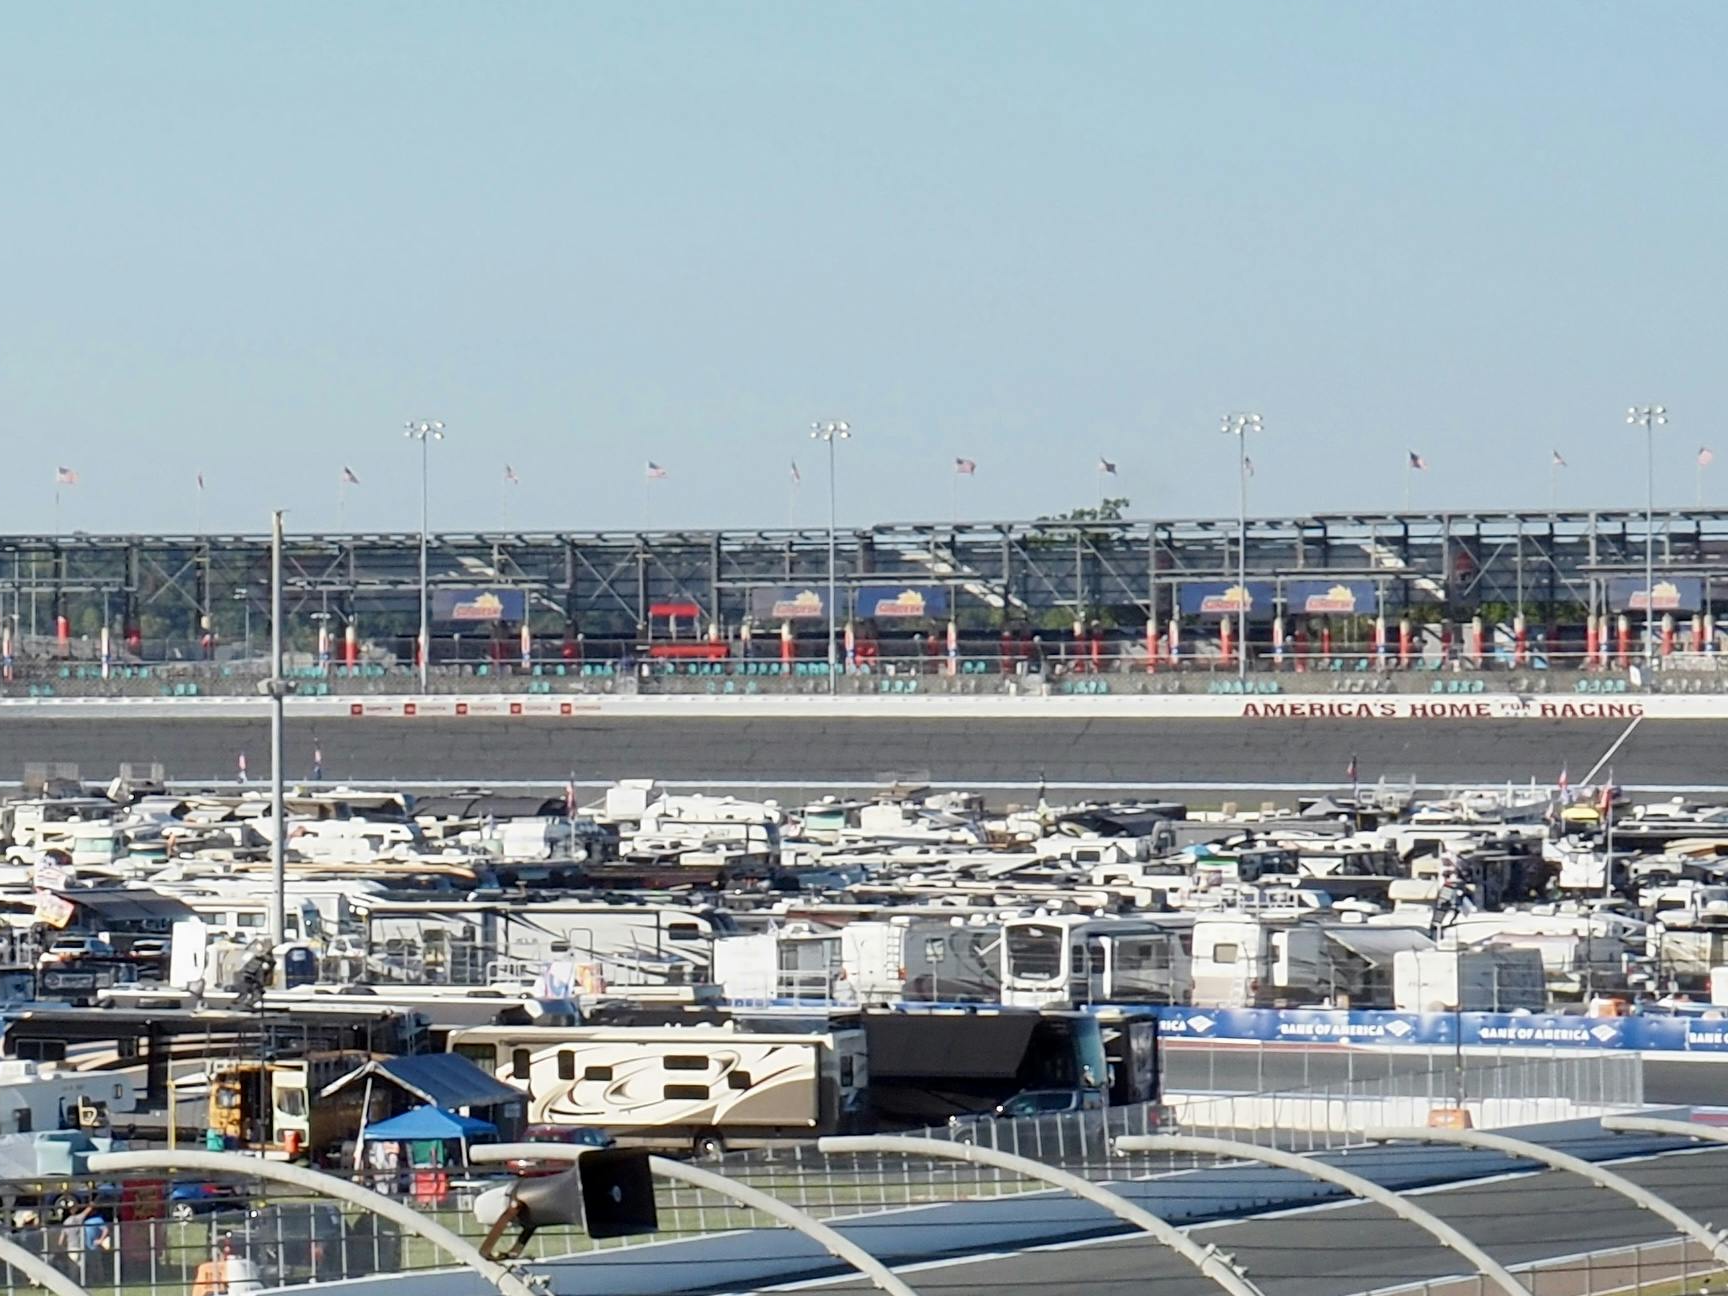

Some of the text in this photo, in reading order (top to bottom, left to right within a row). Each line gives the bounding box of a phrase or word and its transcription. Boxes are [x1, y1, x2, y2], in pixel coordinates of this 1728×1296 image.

[1242, 702, 1397, 717] AMERICA'S
[1409, 702, 1492, 717] HOME
[1540, 702, 1645, 717] RACING
[1281, 1024, 1385, 1036] BANK OF AMERICA
[1480, 1027, 1590, 1041] BANK OF AMERICA
[1689, 1031, 1721, 1044] BANK
